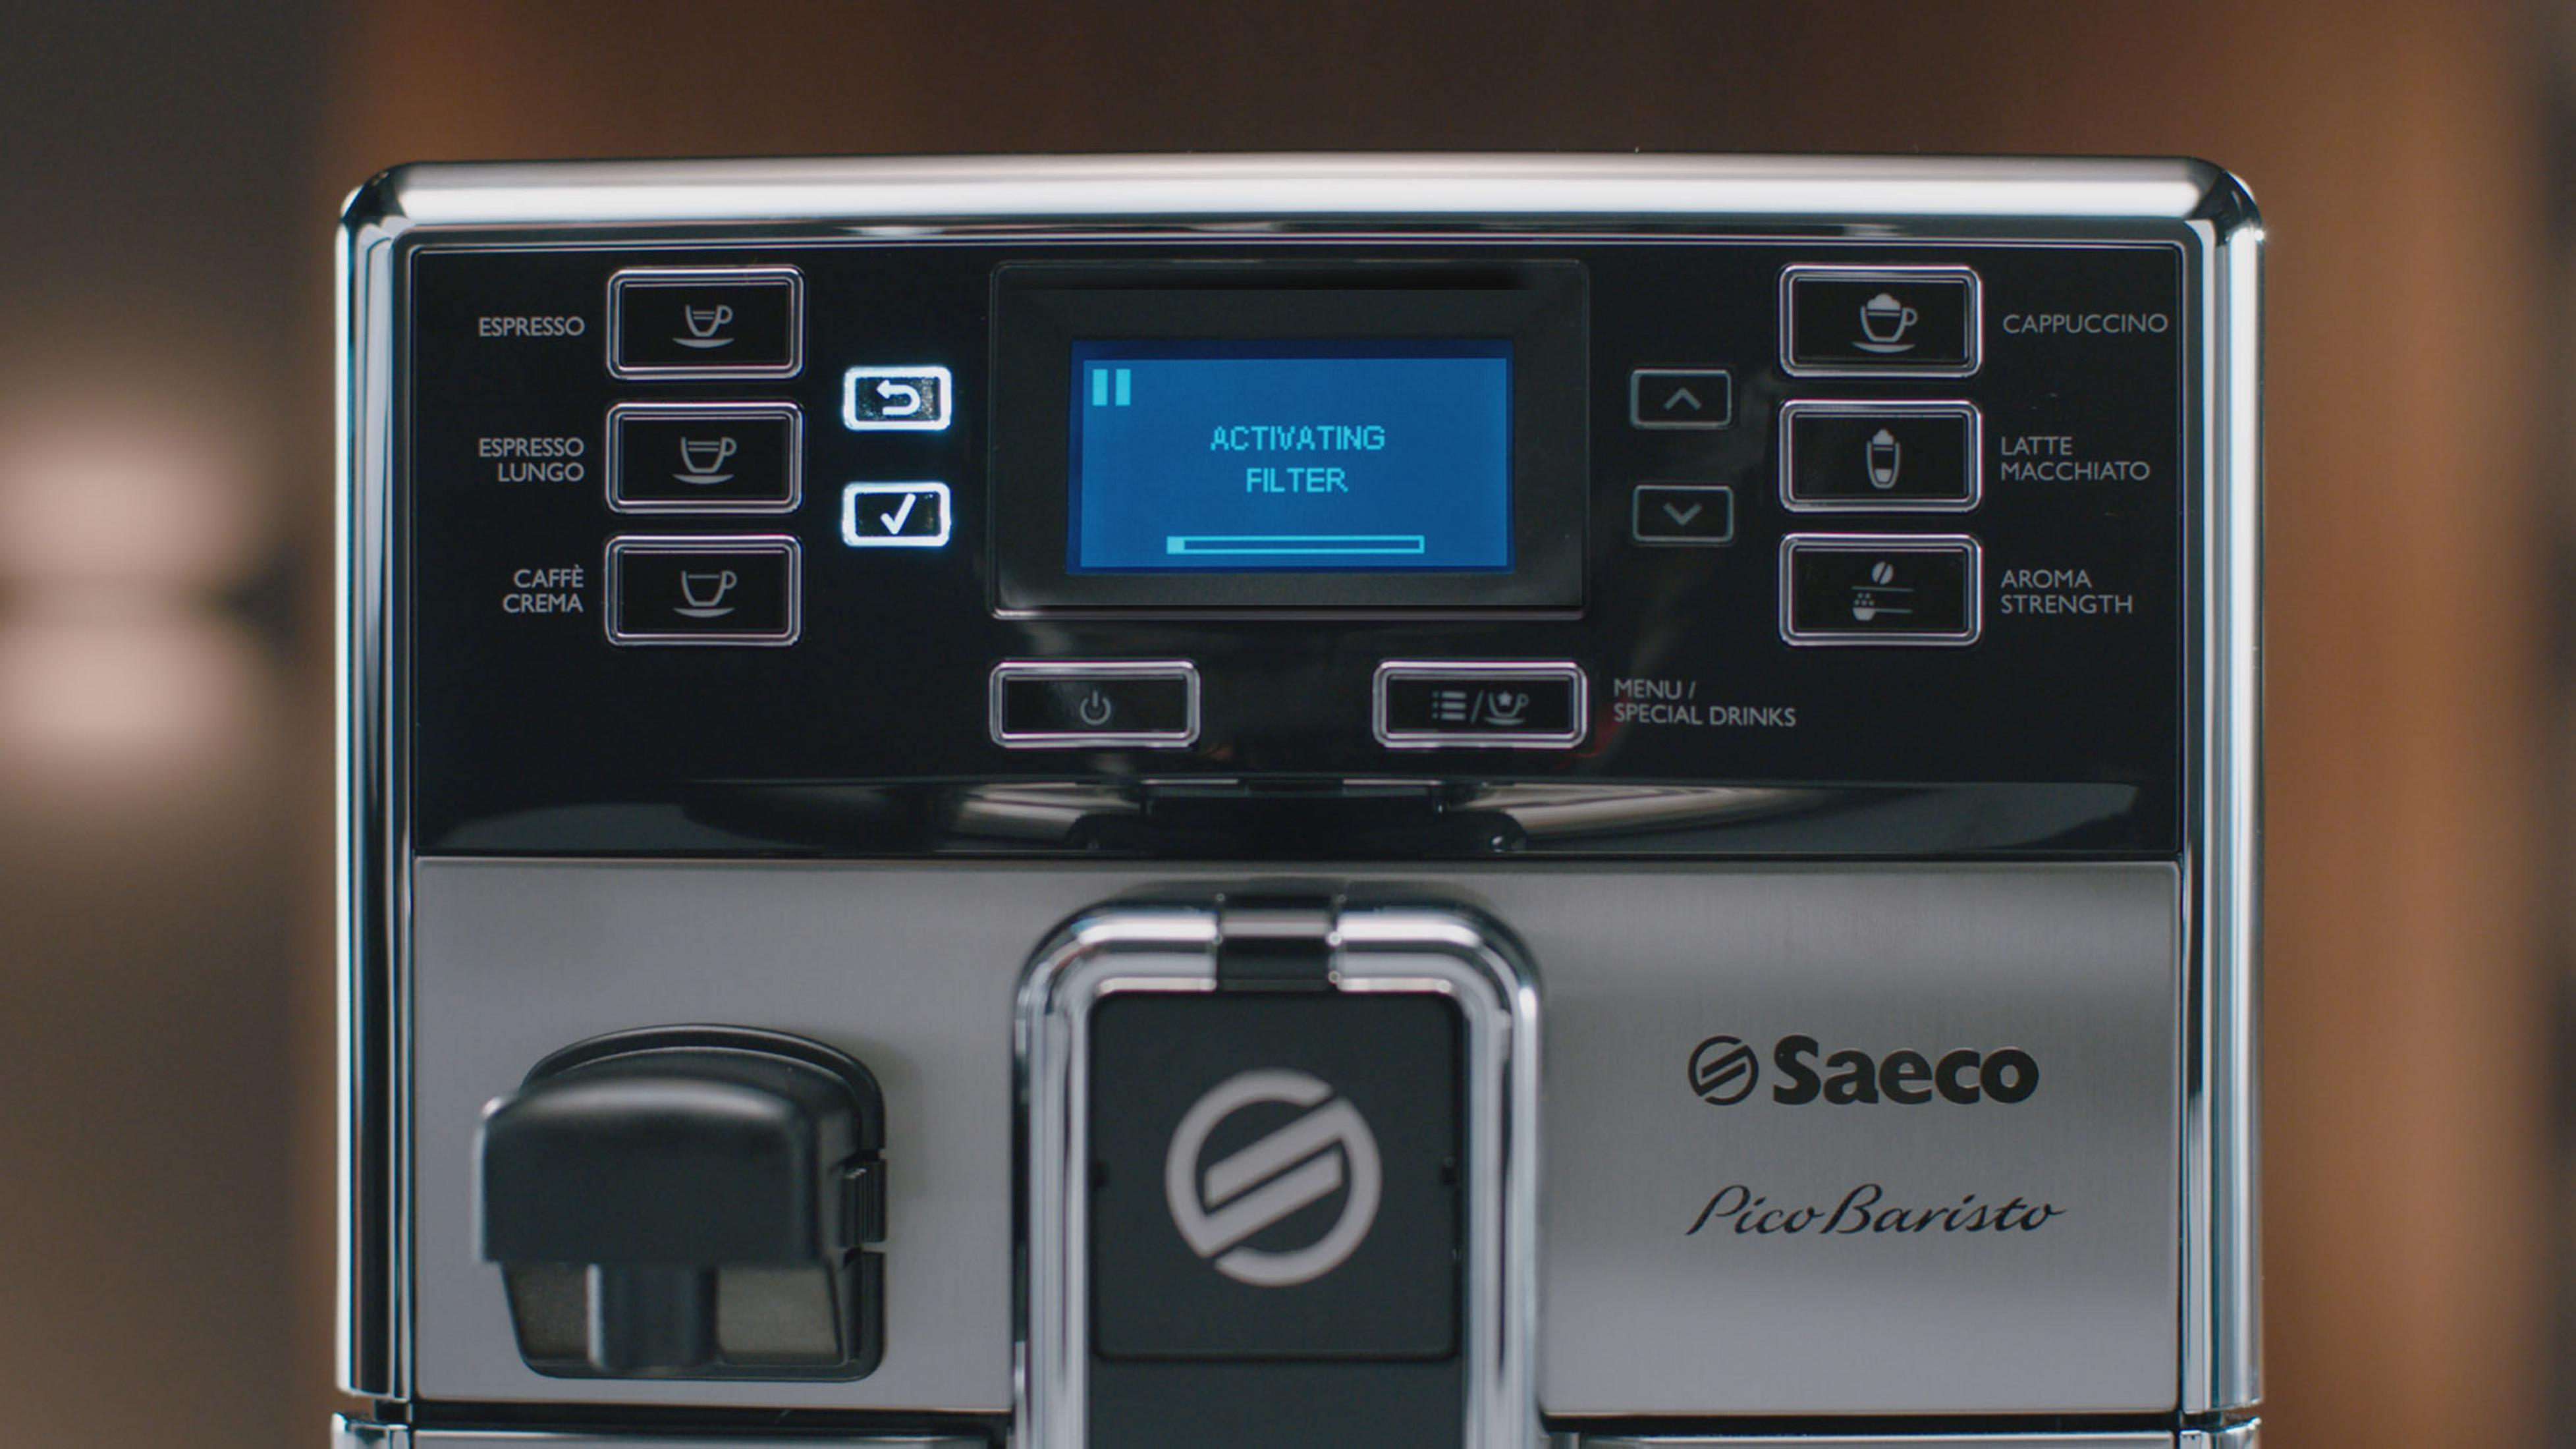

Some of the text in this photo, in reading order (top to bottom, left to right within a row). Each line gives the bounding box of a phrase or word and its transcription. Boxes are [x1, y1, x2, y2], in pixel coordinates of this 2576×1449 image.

[479, 316, 585, 337] ESPRESSO
[2002, 313, 2168, 334] CAPPUCCINO
[479, 437, 584, 458] ESPRESSO
[1211, 425, 1385, 451] ACTIVATING
[2001, 436, 2072, 456] LATTE
[498, 462, 584, 482] LUNGO
[1246, 467, 1348, 493] FILTER
[2001, 461, 2151, 481] MACCHIATO
[513, 564, 584, 588] CAFFÈ
[2000, 569, 2093, 589] AROMA
[503, 593, 584, 613] CREMA
[2001, 594, 2133, 614] STRENGTH
[1614, 678, 1682, 700] MENU
[1614, 703, 1796, 727] SPECIAL DRINKS
[1773, 1034, 2039, 1105] Saeco
